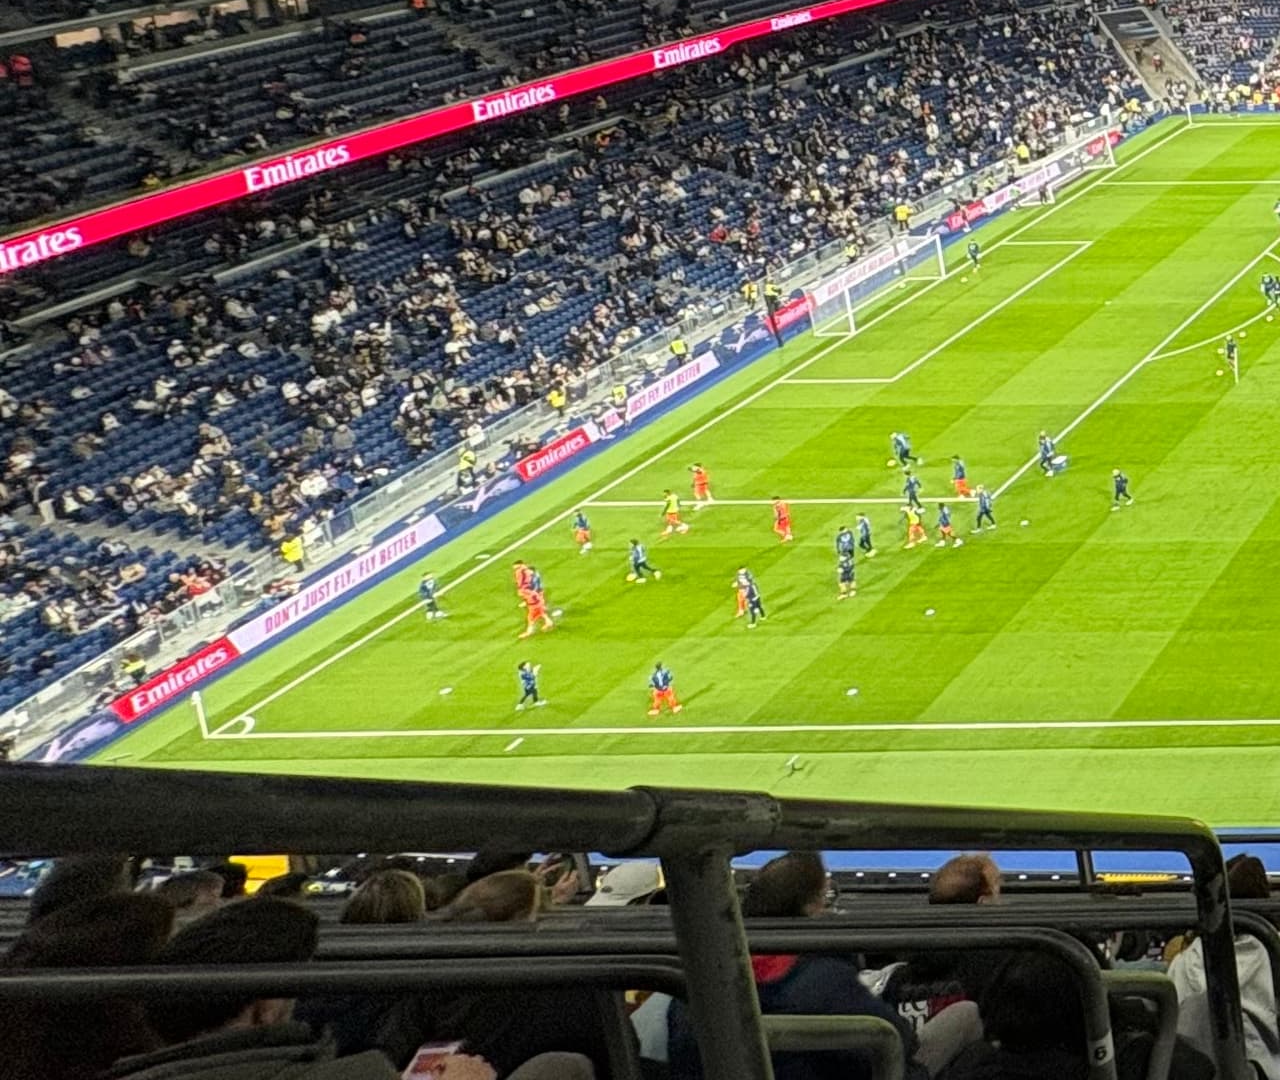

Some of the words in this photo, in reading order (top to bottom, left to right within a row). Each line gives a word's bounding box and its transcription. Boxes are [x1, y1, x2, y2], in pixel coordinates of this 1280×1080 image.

[652, 37, 720, 68] Emirates
[470, 76, 554, 122] Emirates
[229, 134, 349, 193] Emirates
[0, 227, 82, 270] irates
[526, 434, 585, 476] Emirates
[302, 582, 331, 611] JUST
[359, 558, 378, 577] FLY
[379, 531, 417, 566] BETTER
[130, 647, 228, 713] Emirates
